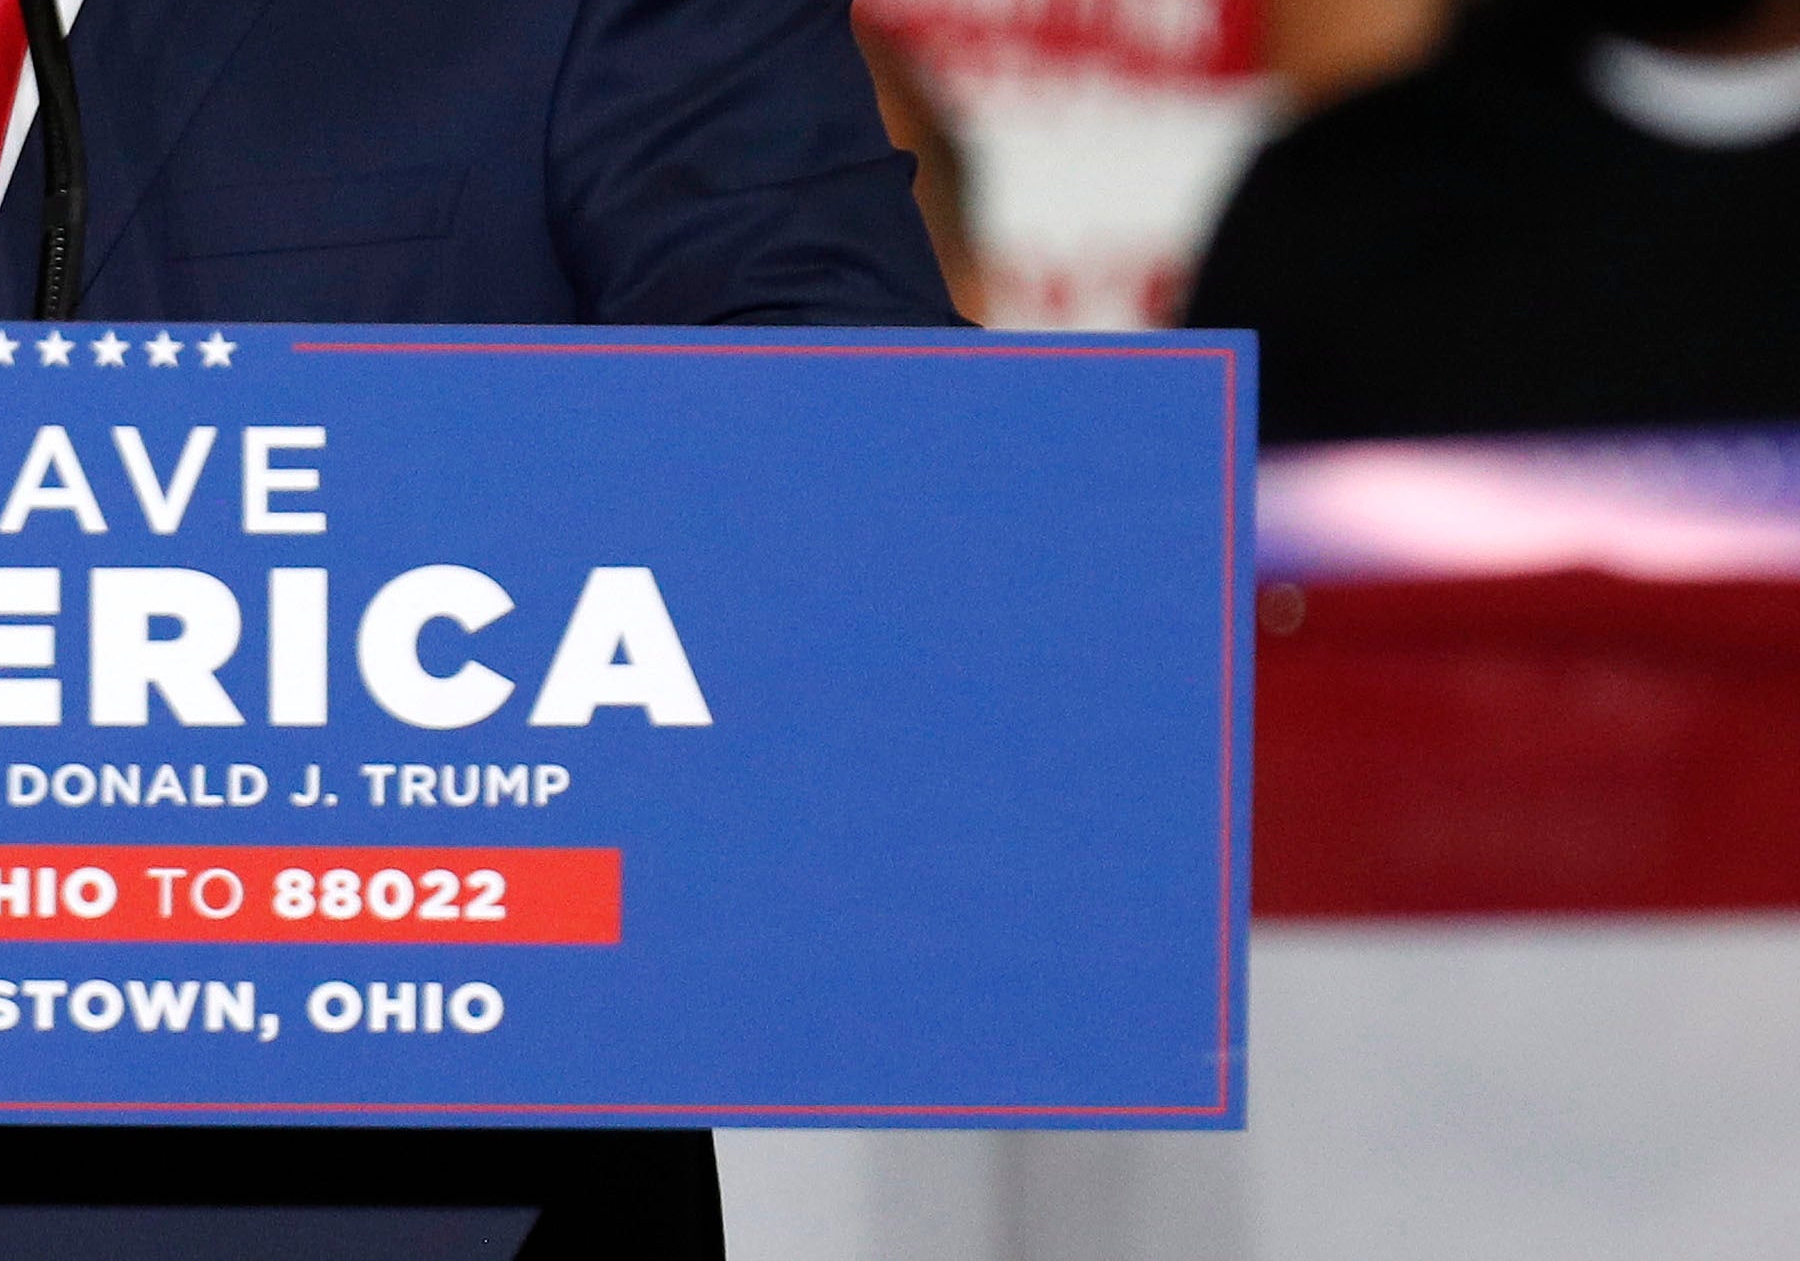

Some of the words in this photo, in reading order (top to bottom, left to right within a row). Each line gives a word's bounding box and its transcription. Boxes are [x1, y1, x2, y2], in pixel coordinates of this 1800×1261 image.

[7, 763, 268, 807] DONALD
[291, 764, 338, 807] J.
[361, 764, 570, 807] TRUMP
[147, 869, 244, 919] TO
[273, 869, 506, 920] 88022
[308, 981, 504, 1033] OHIO
